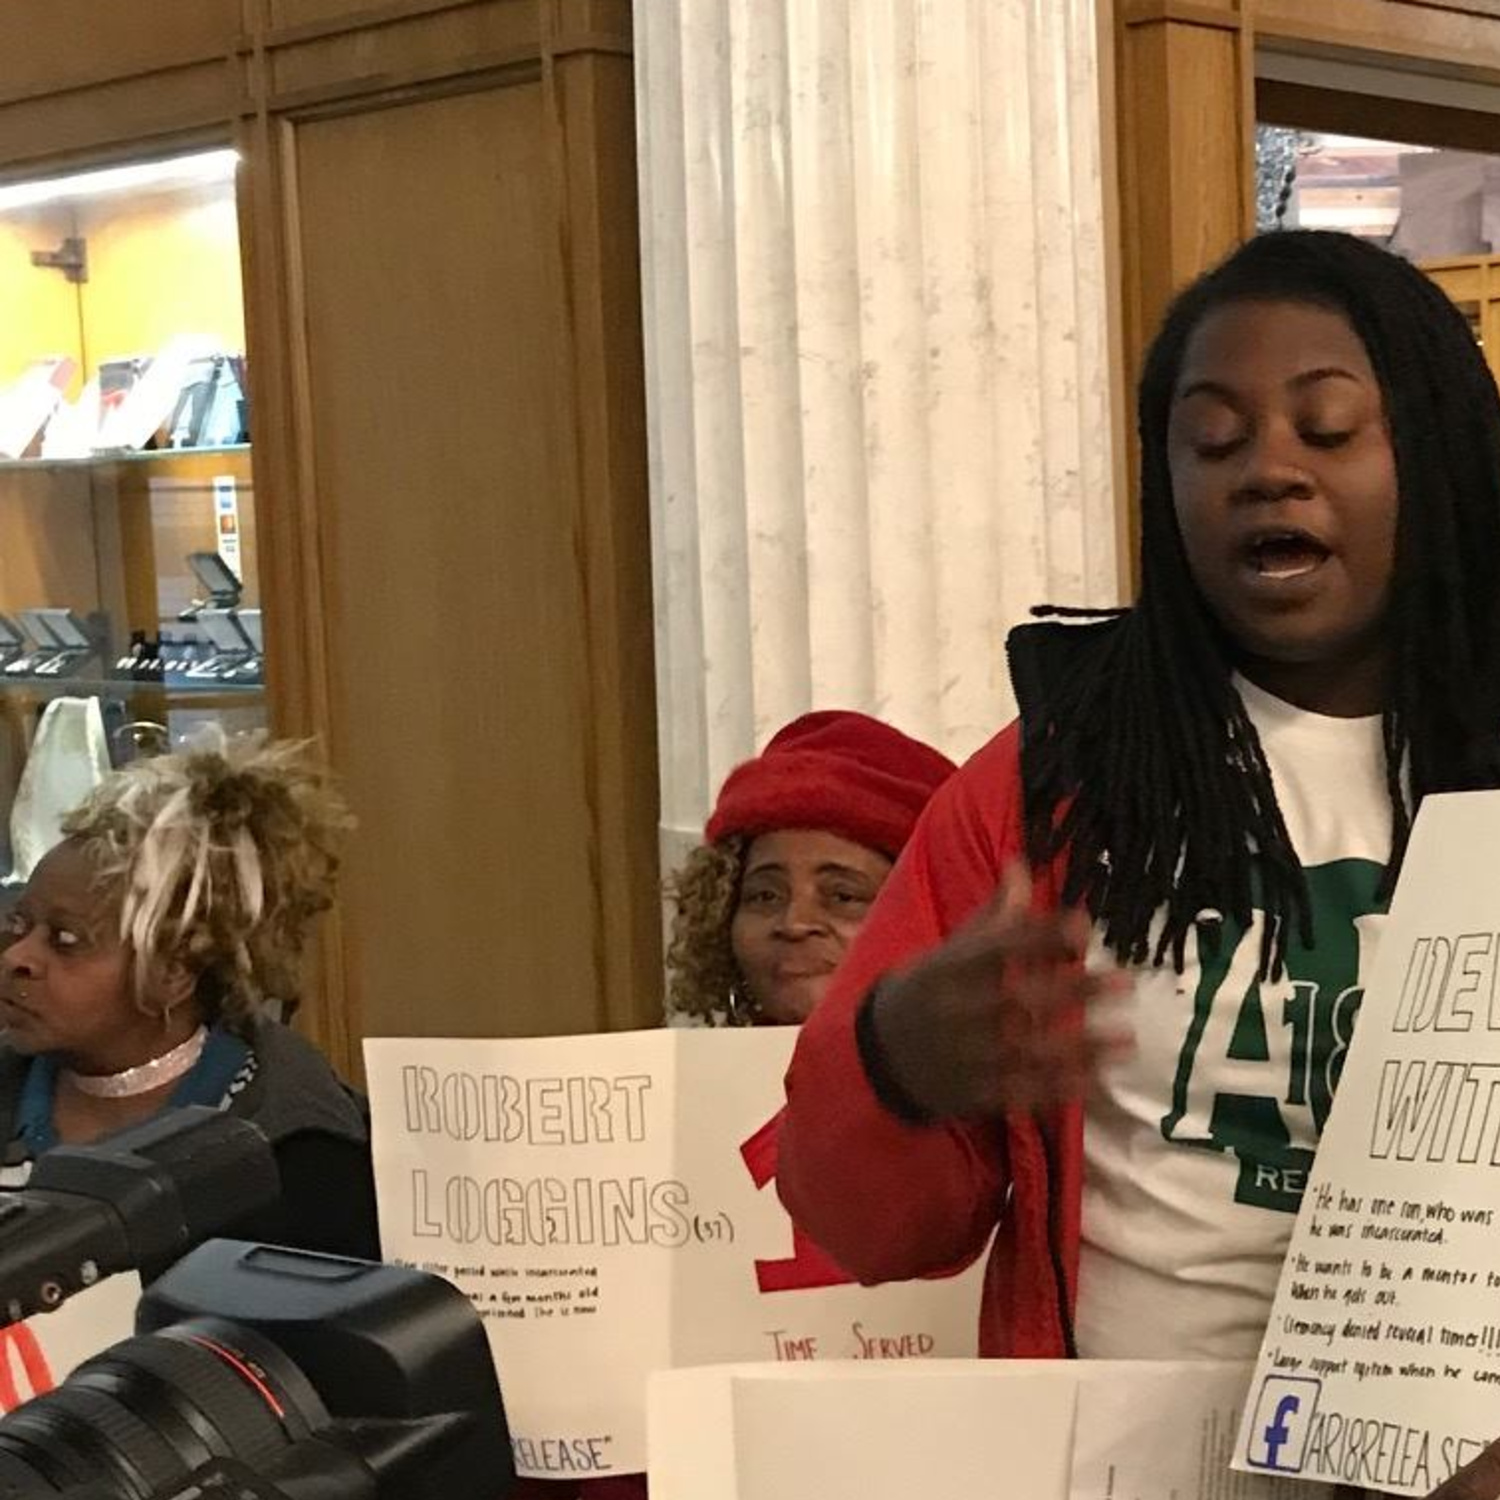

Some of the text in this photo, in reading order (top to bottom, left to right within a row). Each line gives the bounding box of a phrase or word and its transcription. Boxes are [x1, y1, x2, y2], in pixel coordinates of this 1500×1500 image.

[402, 1065, 652, 1146] ROBERT
[411, 1168, 691, 1248] LOGGINS
[1338, 1190, 1363, 1213] has
[1370, 1198, 1395, 1216] one
[1426, 1200, 1455, 1223] who
[1460, 1209, 1494, 1226] was
